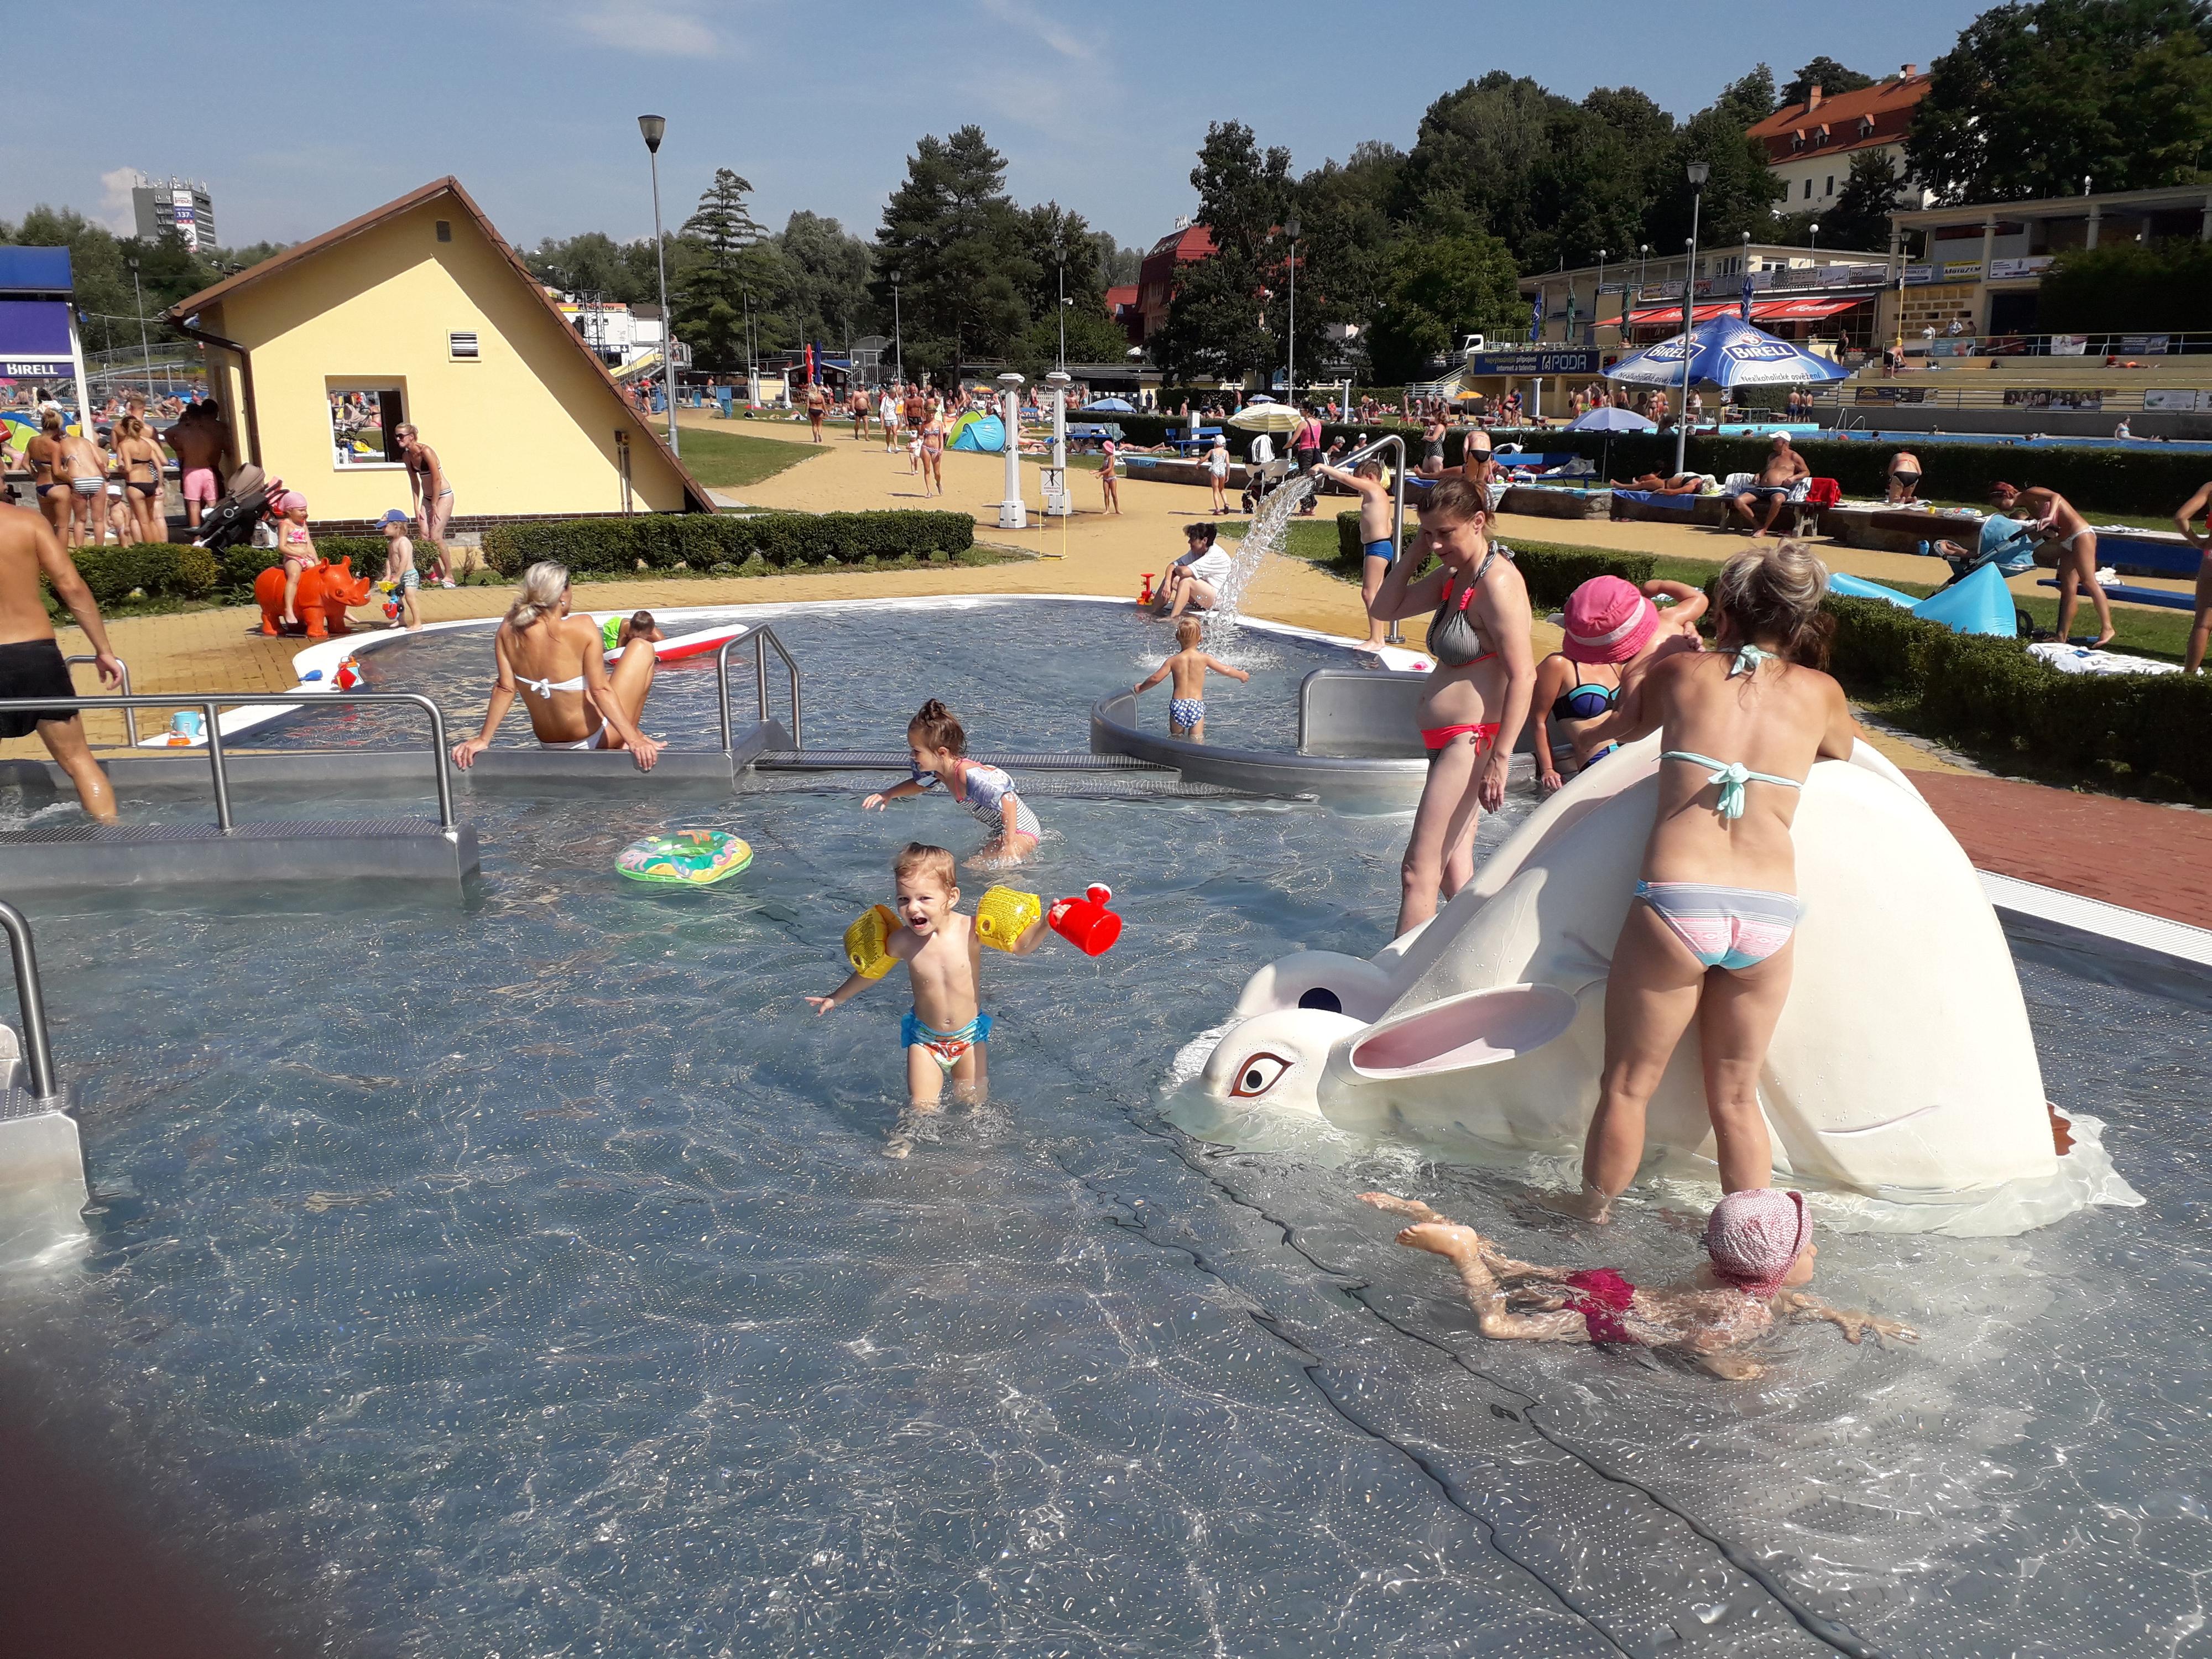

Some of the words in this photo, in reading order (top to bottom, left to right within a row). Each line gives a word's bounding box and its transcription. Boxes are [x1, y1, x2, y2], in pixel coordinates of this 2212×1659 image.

[1731, 346, 1793, 358] BIRELL
[1552, 354, 1587, 370] PODA
[7, 363, 59, 375] BIRELL
[1791, 372, 1820, 381] osvěžení
